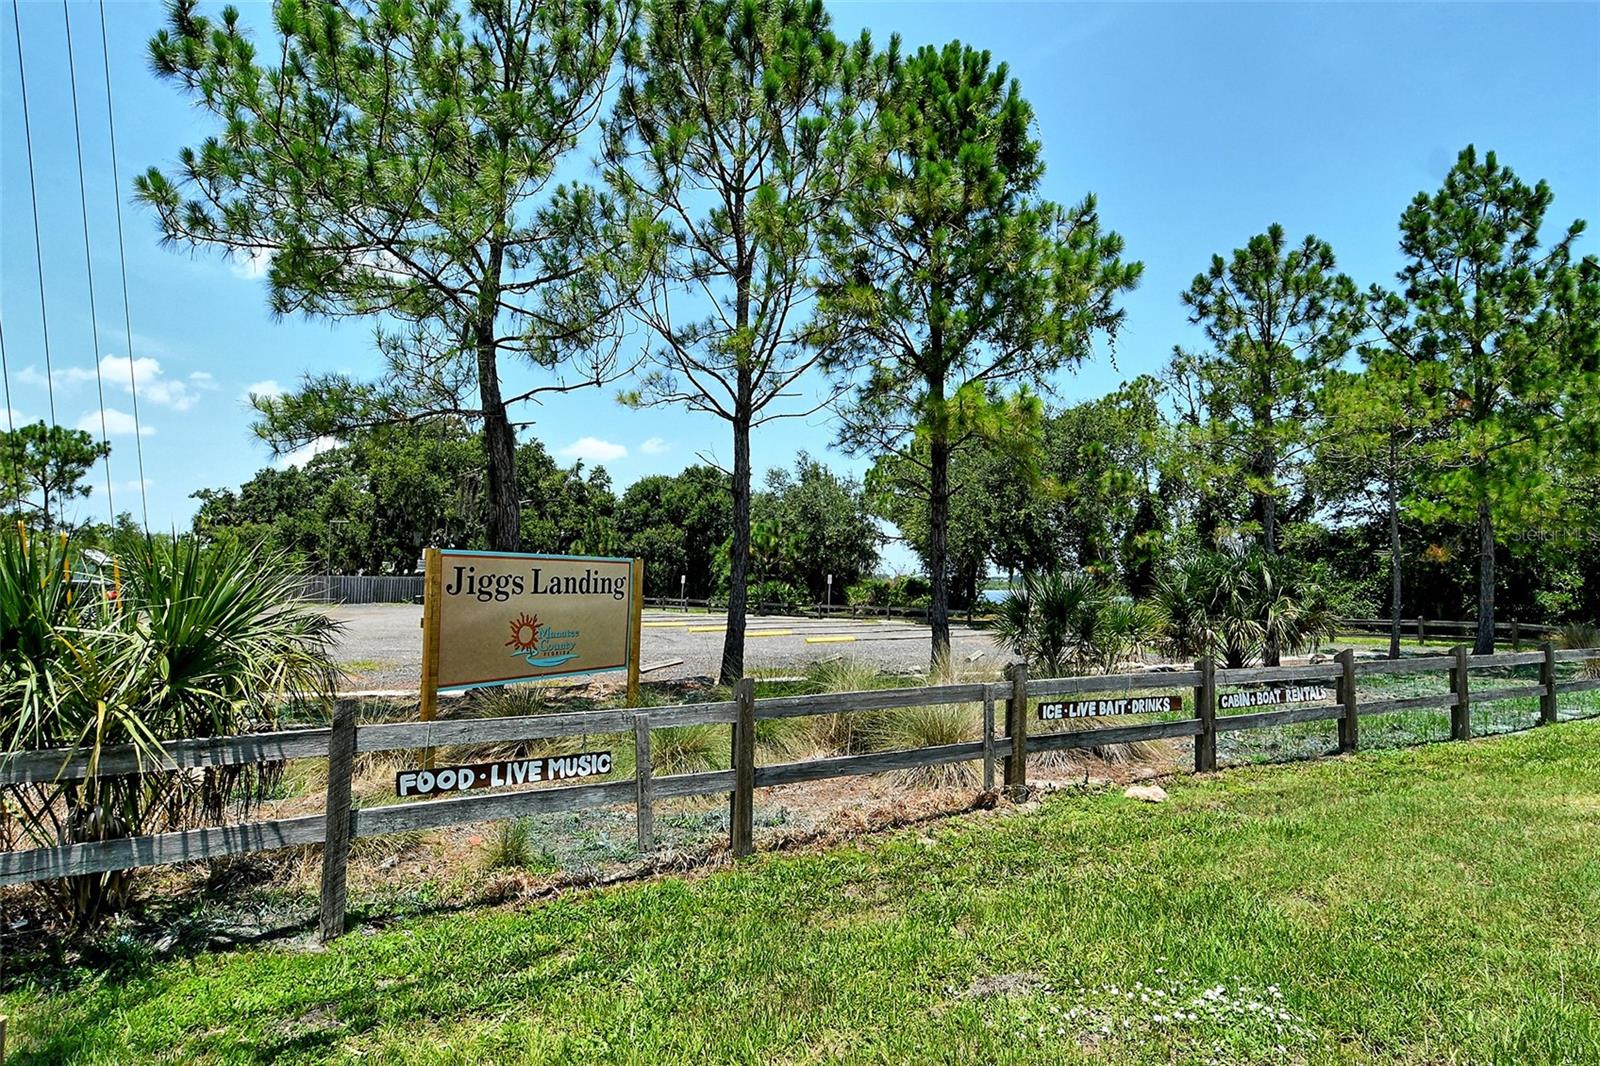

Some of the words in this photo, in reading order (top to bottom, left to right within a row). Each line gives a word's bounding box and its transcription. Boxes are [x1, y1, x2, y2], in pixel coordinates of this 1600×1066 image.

[446, 566, 524, 602] Jiggs
[531, 568, 626, 600] Landing
[540, 639, 577, 652] County
[1285, 685, 1328, 702] RENTALS
[1042, 704, 1063, 719] ICE
[1099, 700, 1127, 715] BAIT
[1131, 698, 1171, 713] DRINKS
[400, 768, 475, 796] FOOD
[491, 761, 543, 786] LIVE
[547, 754, 611, 780] MUSIC
